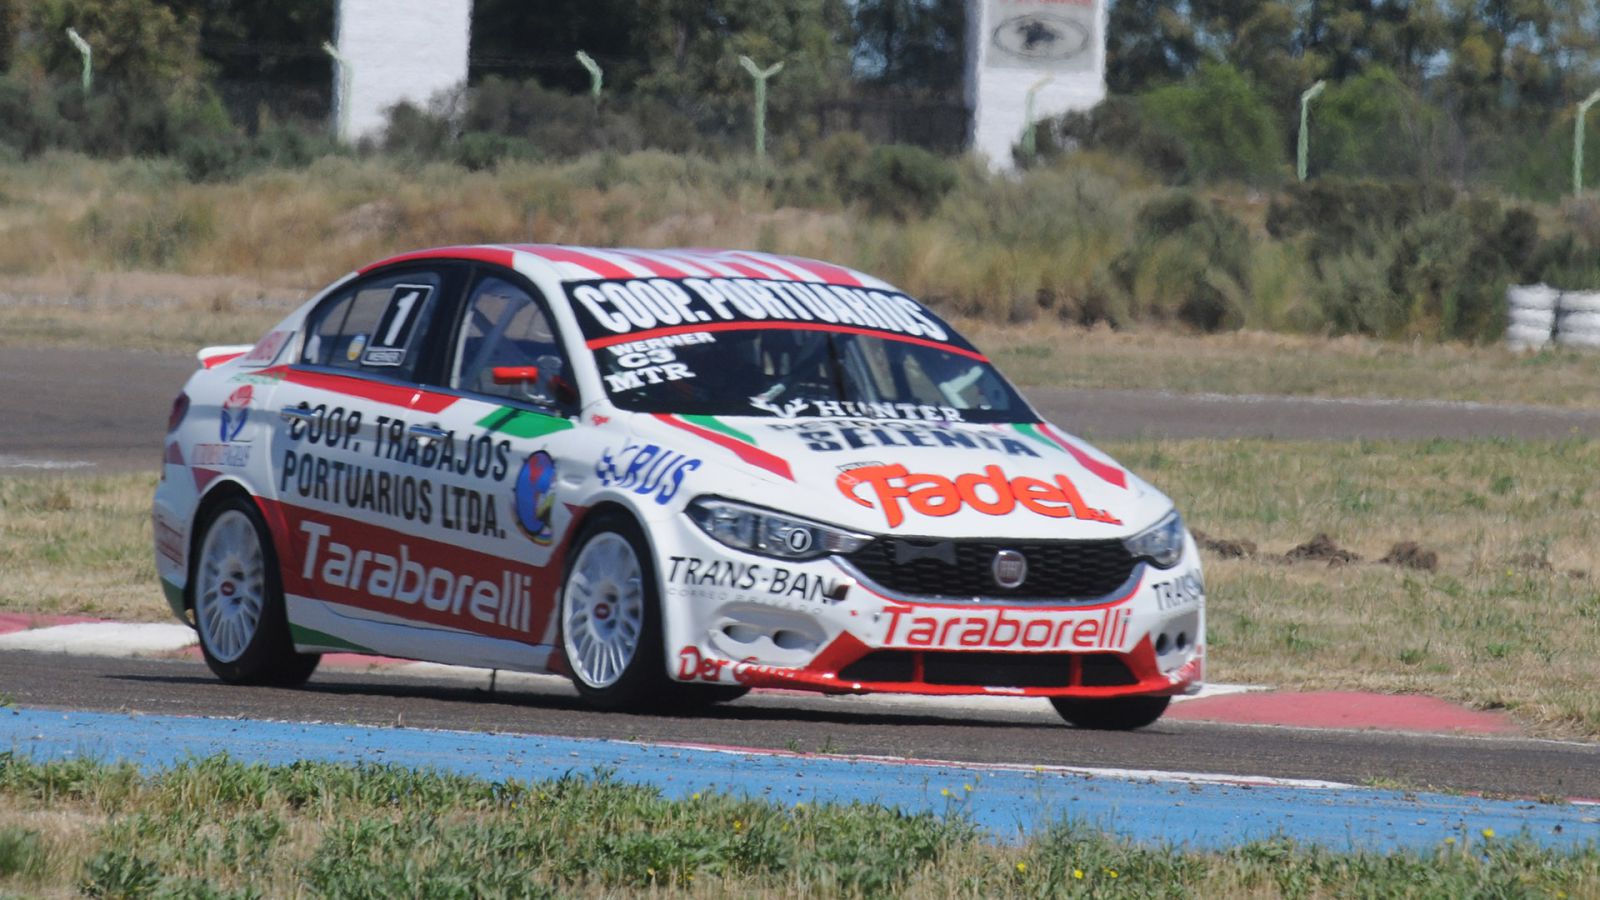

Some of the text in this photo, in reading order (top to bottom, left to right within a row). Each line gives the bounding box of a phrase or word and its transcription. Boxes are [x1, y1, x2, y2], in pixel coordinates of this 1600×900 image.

[384, 291, 420, 346] 1
[573, 278, 948, 342] COOP. PORTUARIOS
[606, 331, 717, 356] WERNER
[617, 348, 676, 368] C3
[603, 362, 696, 393] MTR
[812, 400, 965, 422] HUNTER
[289, 401, 511, 482] COOP. TRABAJOS
[280, 450, 506, 539] PORTUARIOS LTDA.
[836, 463, 1092, 528] Fadel
[300, 520, 532, 633] Taraborelli
[882, 606, 1132, 648] Taraborelli
